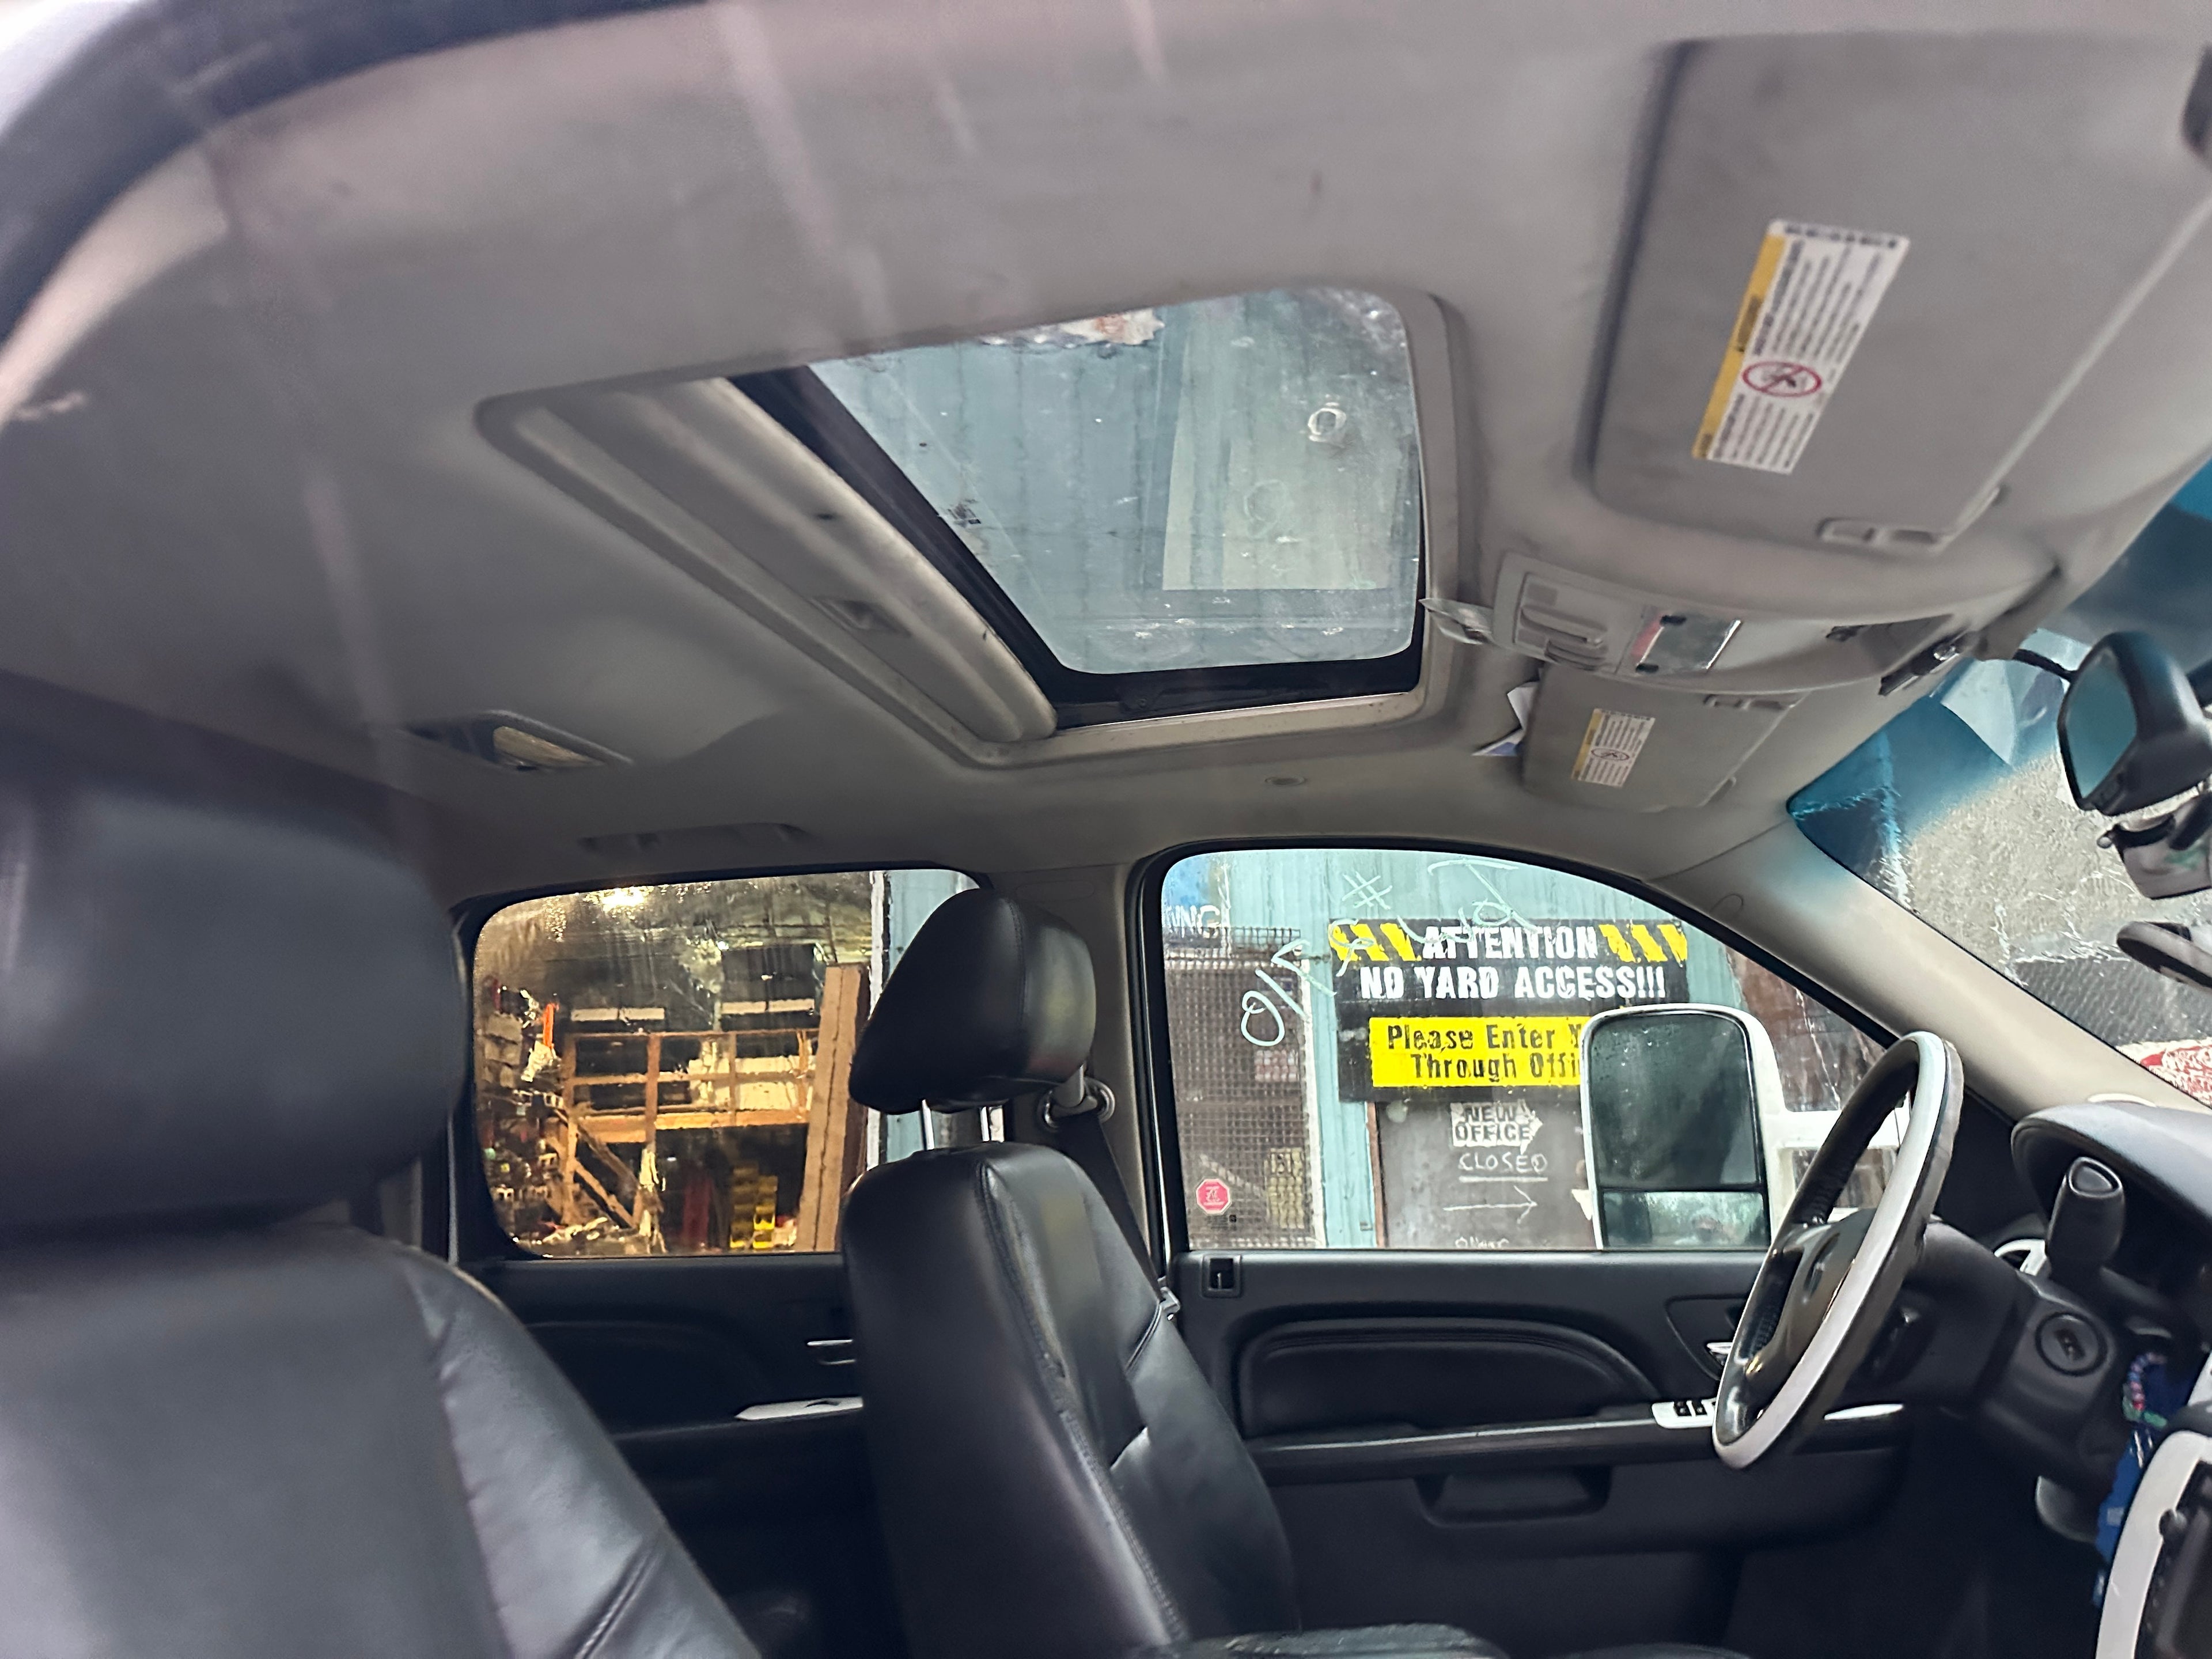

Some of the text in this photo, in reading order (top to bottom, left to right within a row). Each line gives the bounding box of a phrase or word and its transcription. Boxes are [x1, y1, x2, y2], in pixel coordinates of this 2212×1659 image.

[1422, 926, 1598, 959] ATTENTION
[1360, 966, 1666, 999] NO YARD ACCESS!!!
[1388, 1024, 1474, 1050] Please
[1486, 1023, 1555, 1049] Enter
[1411, 1052, 1581, 1082] Through Offi
[1465, 1104, 1514, 1122] NEW
[1455, 1123, 1531, 1142] OFFICE
[1458, 1152, 1548, 1174] CLOSED
